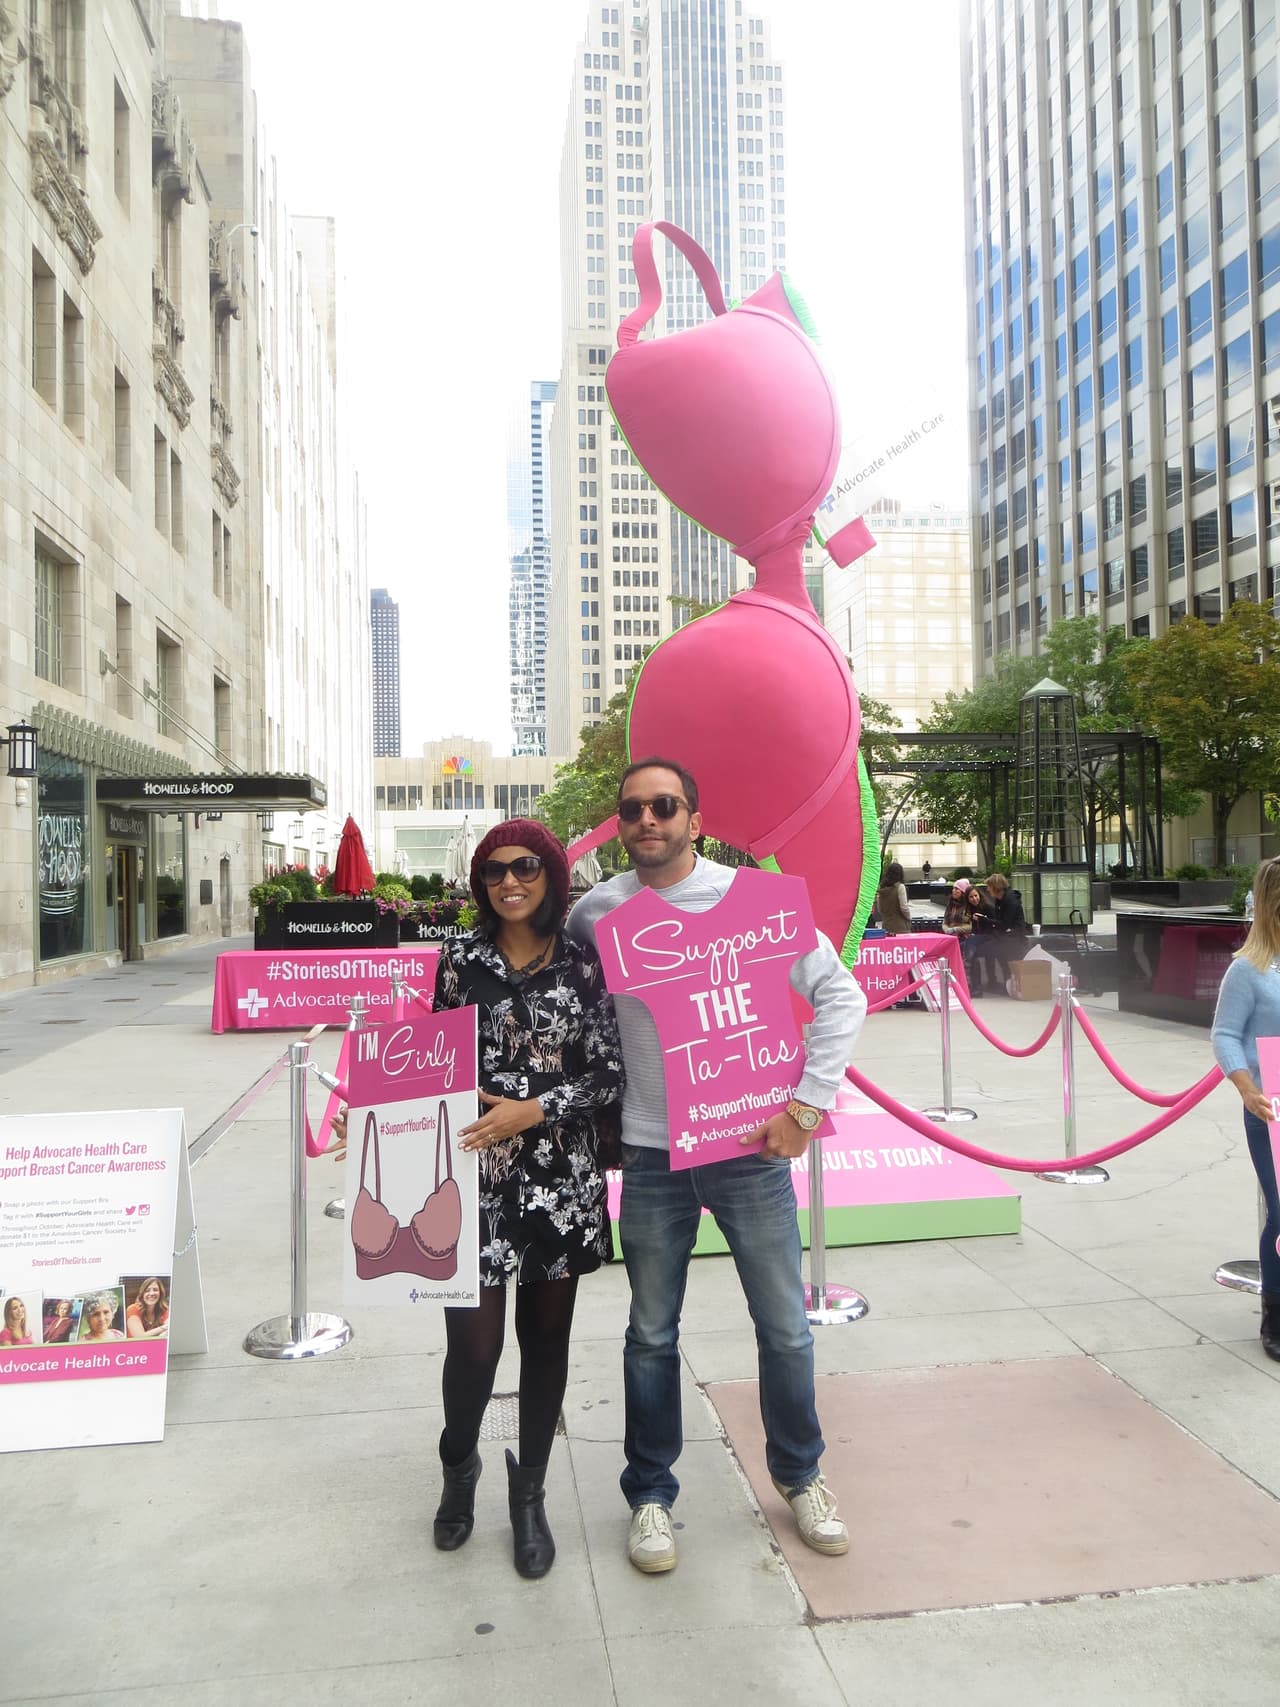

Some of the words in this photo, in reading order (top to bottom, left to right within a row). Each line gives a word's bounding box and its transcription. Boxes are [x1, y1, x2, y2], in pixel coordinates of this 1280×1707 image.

[835, 457, 885, 498] Advocate
[886, 429, 922, 460] Health
[921, 413, 945, 434] Care
[143, 782, 191, 795] HOWELLS
[200, 782, 234, 795] HOOD
[287, 921, 332, 933] HOWELLS
[339, 921, 373, 933] HOOD
[416, 923, 467, 938] HOWELL
[612, 926, 629, 978] I
[631, 909, 798, 986] Support
[266, 958, 424, 981] #StoriesOfTheGirls
[273, 991, 351, 1008] Advocate
[358, 990, 410, 1006] Healh
[689, 982, 758, 1032] THE
[358, 1031, 379, 1062] I'M
[382, 1025, 456, 1089] Girly
[665, 1025, 799, 1085] Ta-Tas
[688, 1084, 798, 1123] #SupportYourGirls
[380, 1116, 437, 1136] #SupportYourGirls
[700, 1122, 755, 1143] Advocate
[5, 1147, 30, 1162] Help
[32, 1145, 82, 1160] Advocate
[84, 1143, 120, 1157] Health
[122, 1141, 148, 1154] Care
[29, 1163, 65, 1177] Breast
[68, 1161, 105, 1175] Cancer
[107, 1159, 167, 1173] Awareness
[31, 1255, 102, 1268] StoriesOfTheGirls.com
[420, 1290, 443, 1300] Advocate
[443, 1290, 461, 1299] Health
[461, 1290, 475, 1300] Care
[65, 1354, 111, 1369] Health
[115, 1353, 148, 1366] Care
